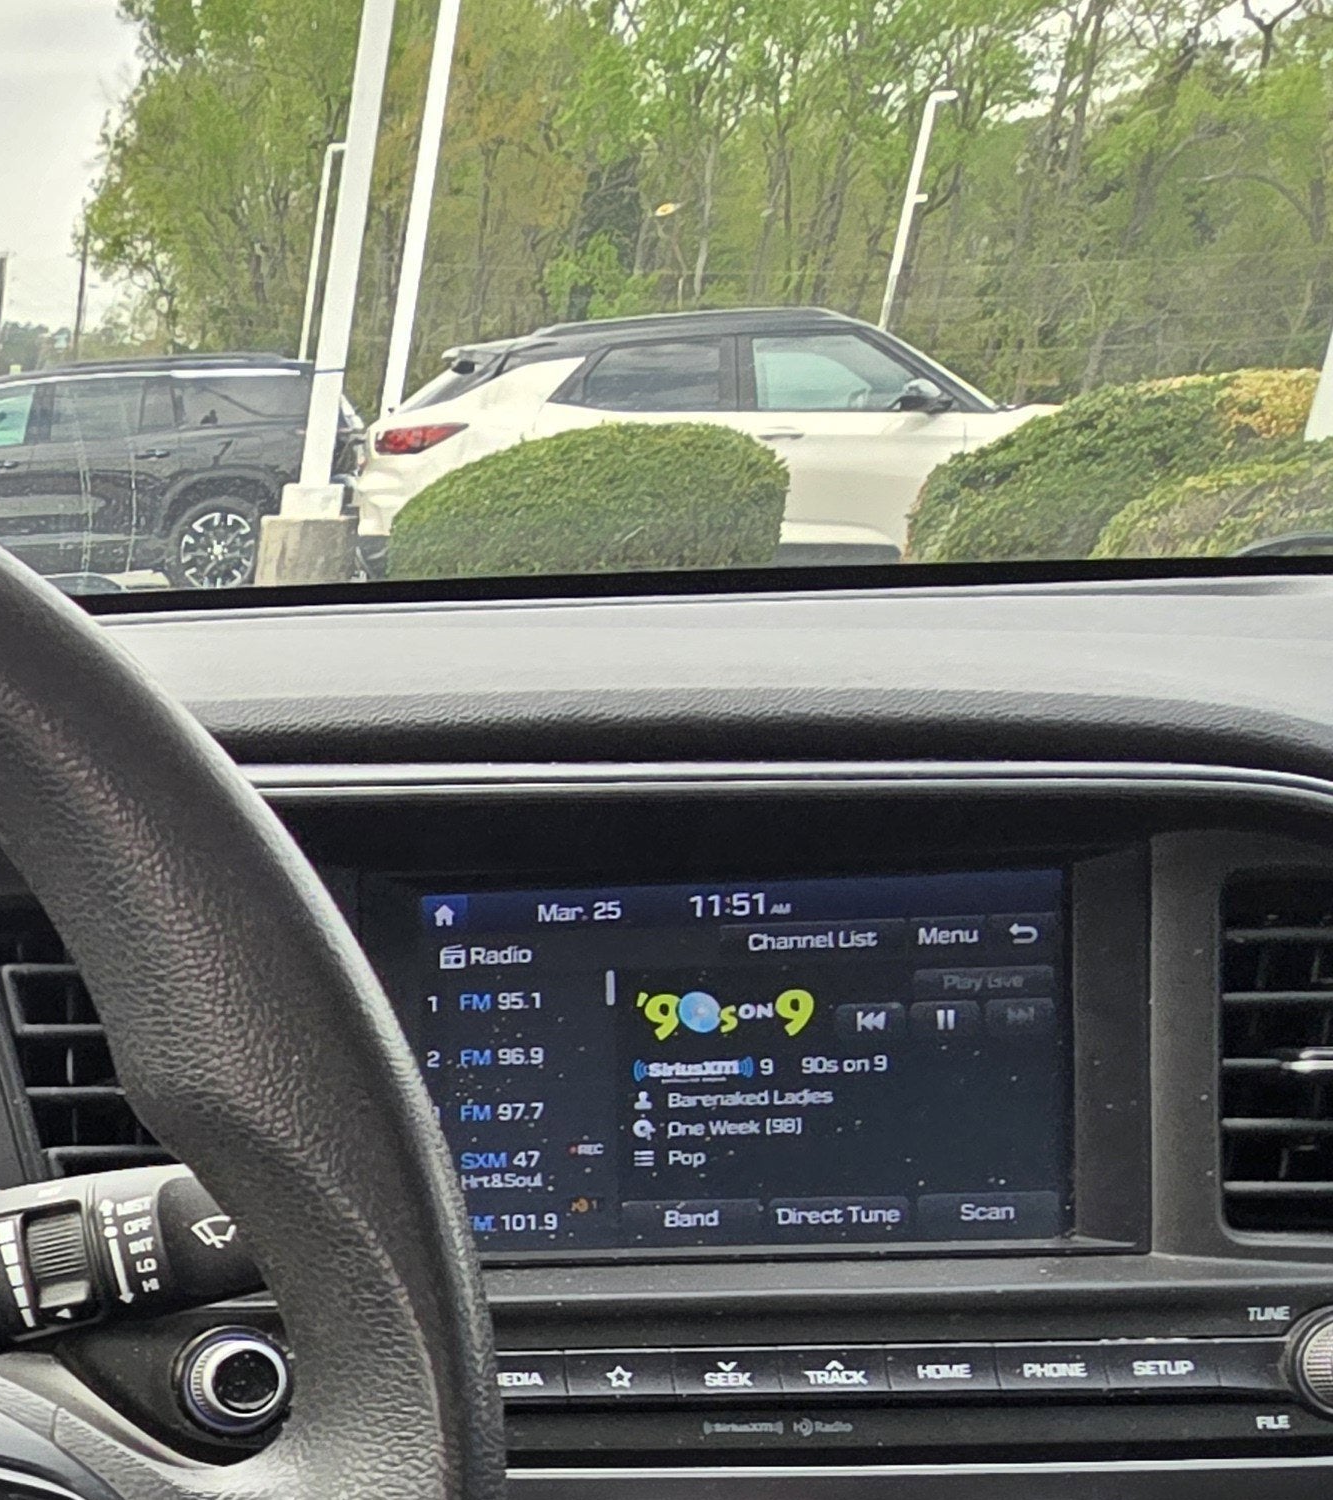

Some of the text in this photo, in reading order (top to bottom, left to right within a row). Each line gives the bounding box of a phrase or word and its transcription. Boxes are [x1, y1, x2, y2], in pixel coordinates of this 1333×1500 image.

[592, 901, 622, 921] 25
[688, 893, 791, 918] 11:51 AM
[748, 929, 878, 951] Channel List
[918, 926, 980, 945] Menu
[470, 945, 533, 966] Radio
[943, 974, 983, 992] Play
[427, 992, 542, 1013] 1 FM 95.1
[774, 989, 815, 1036] 9
[427, 1047, 544, 1068] 2 FM 96.9
[760, 1058, 774, 1075] 9
[801, 1056, 839, 1075] 90s
[842, 1057, 869, 1073] on
[873, 1055, 888, 1071] 9
[667, 1089, 834, 1108] Barenaked Ladies
[460, 1104, 492, 1122] FM
[497, 1102, 544, 1121] 97.7
[667, 1120, 705, 1137] One
[709, 1119, 760, 1135] Week
[460, 1151, 540, 1169] SXM 47
[668, 1150, 706, 1168] Pop
[663, 1210, 719, 1228] Band
[776, 1205, 901, 1225] Direct Tune
[960, 1202, 1015, 1220] Scan
[500, 1213, 558, 1231] 101.9
[136, 1258, 157, 1273] LO
[1247, 1306, 1291, 1321] TUNE
[803, 1370, 868, 1386] TRACK
[917, 1364, 972, 1379] HOME
[1023, 1363, 1088, 1379] PHONE
[1132, 1361, 1195, 1377] SETUP
[704, 1372, 753, 1387] SEEK
[1256, 1415, 1291, 1430] FILE
